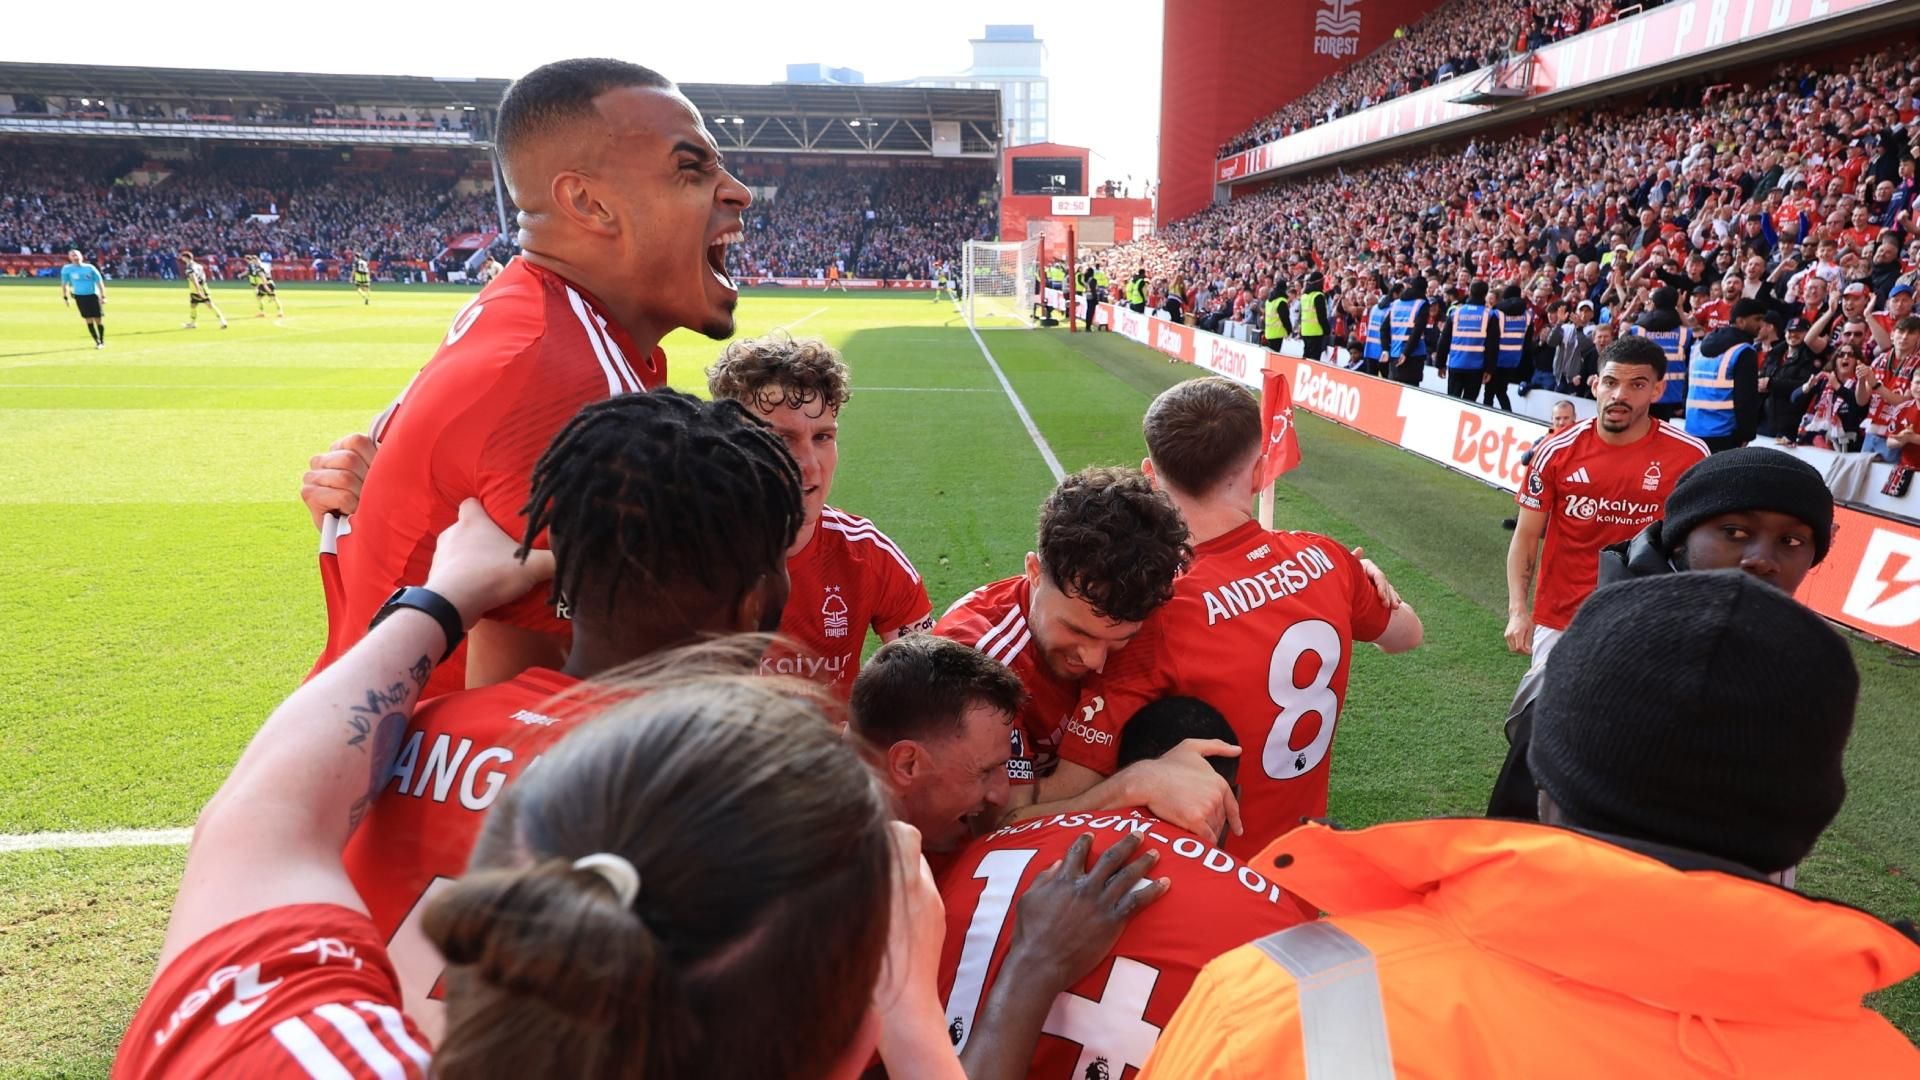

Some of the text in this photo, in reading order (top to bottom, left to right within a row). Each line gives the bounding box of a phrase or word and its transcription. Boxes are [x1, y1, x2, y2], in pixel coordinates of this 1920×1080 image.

[1314, 36, 1359, 59] FOREST
[1556, 19, 1647, 88] WITH
[1646, 331, 1680, 339] SECURITY
[1210, 339, 1247, 379] Betano
[1292, 362, 1361, 423] Betano
[1452, 409, 1534, 485] Beta
[1596, 513, 1654, 526] kaiyun.com
[1598, 497, 1660, 515] kaiyun
[1202, 544, 1336, 626] ANDERSON
[824, 627, 849, 639] FOREST
[1261, 618, 1342, 780] 8
[386, 730, 541, 812] ANG
[1008, 769, 1034, 780] acism
